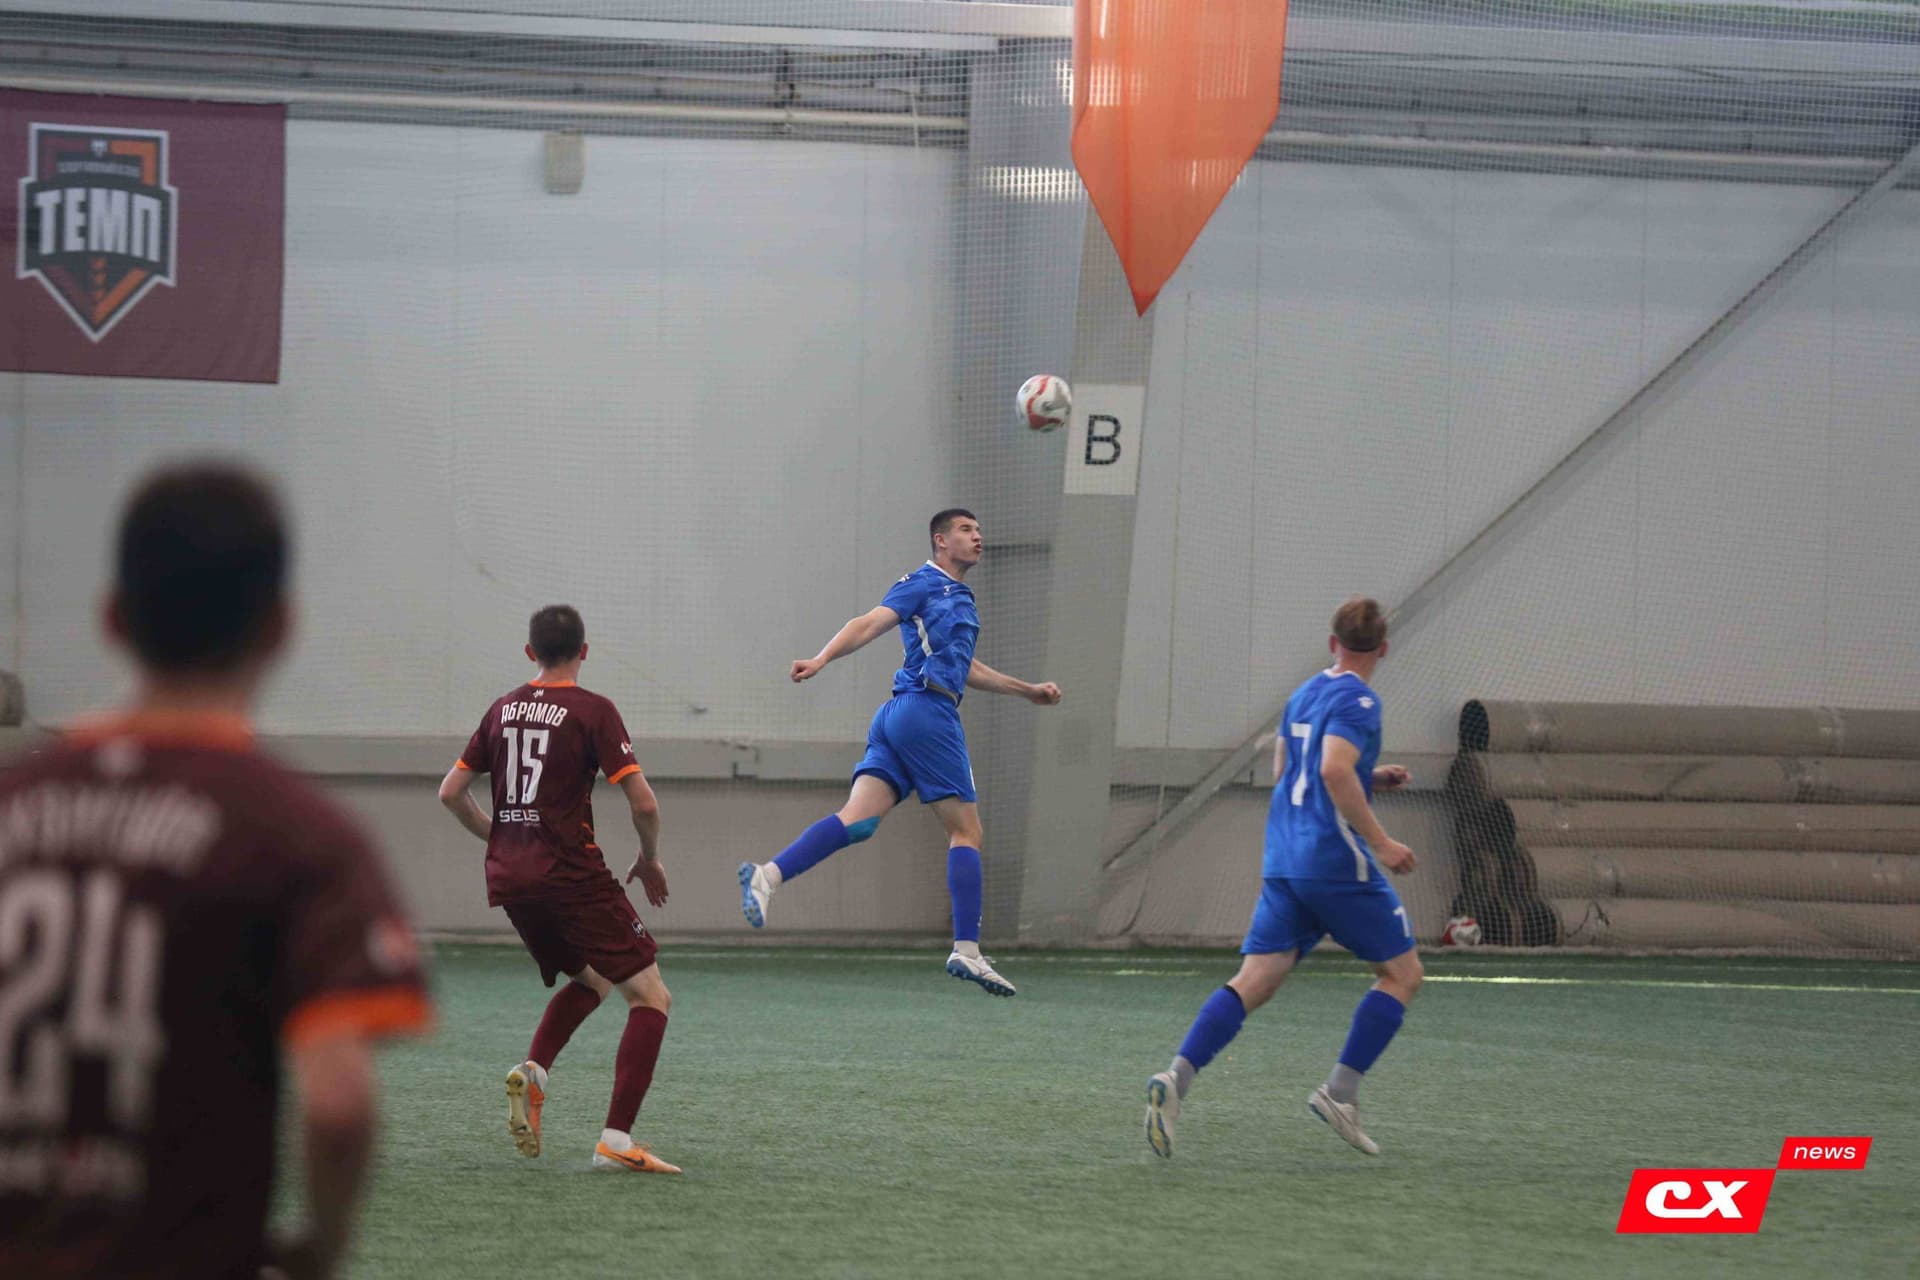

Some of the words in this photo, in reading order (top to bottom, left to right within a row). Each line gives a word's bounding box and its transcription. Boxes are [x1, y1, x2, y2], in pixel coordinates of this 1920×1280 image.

[34, 187, 162, 262] ТЕМП
[501, 701, 568, 727] АБРАМОВ
[502, 727, 549, 805] 15
[1290, 722, 1313, 806] 7
[0, 864, 166, 1130] 24
